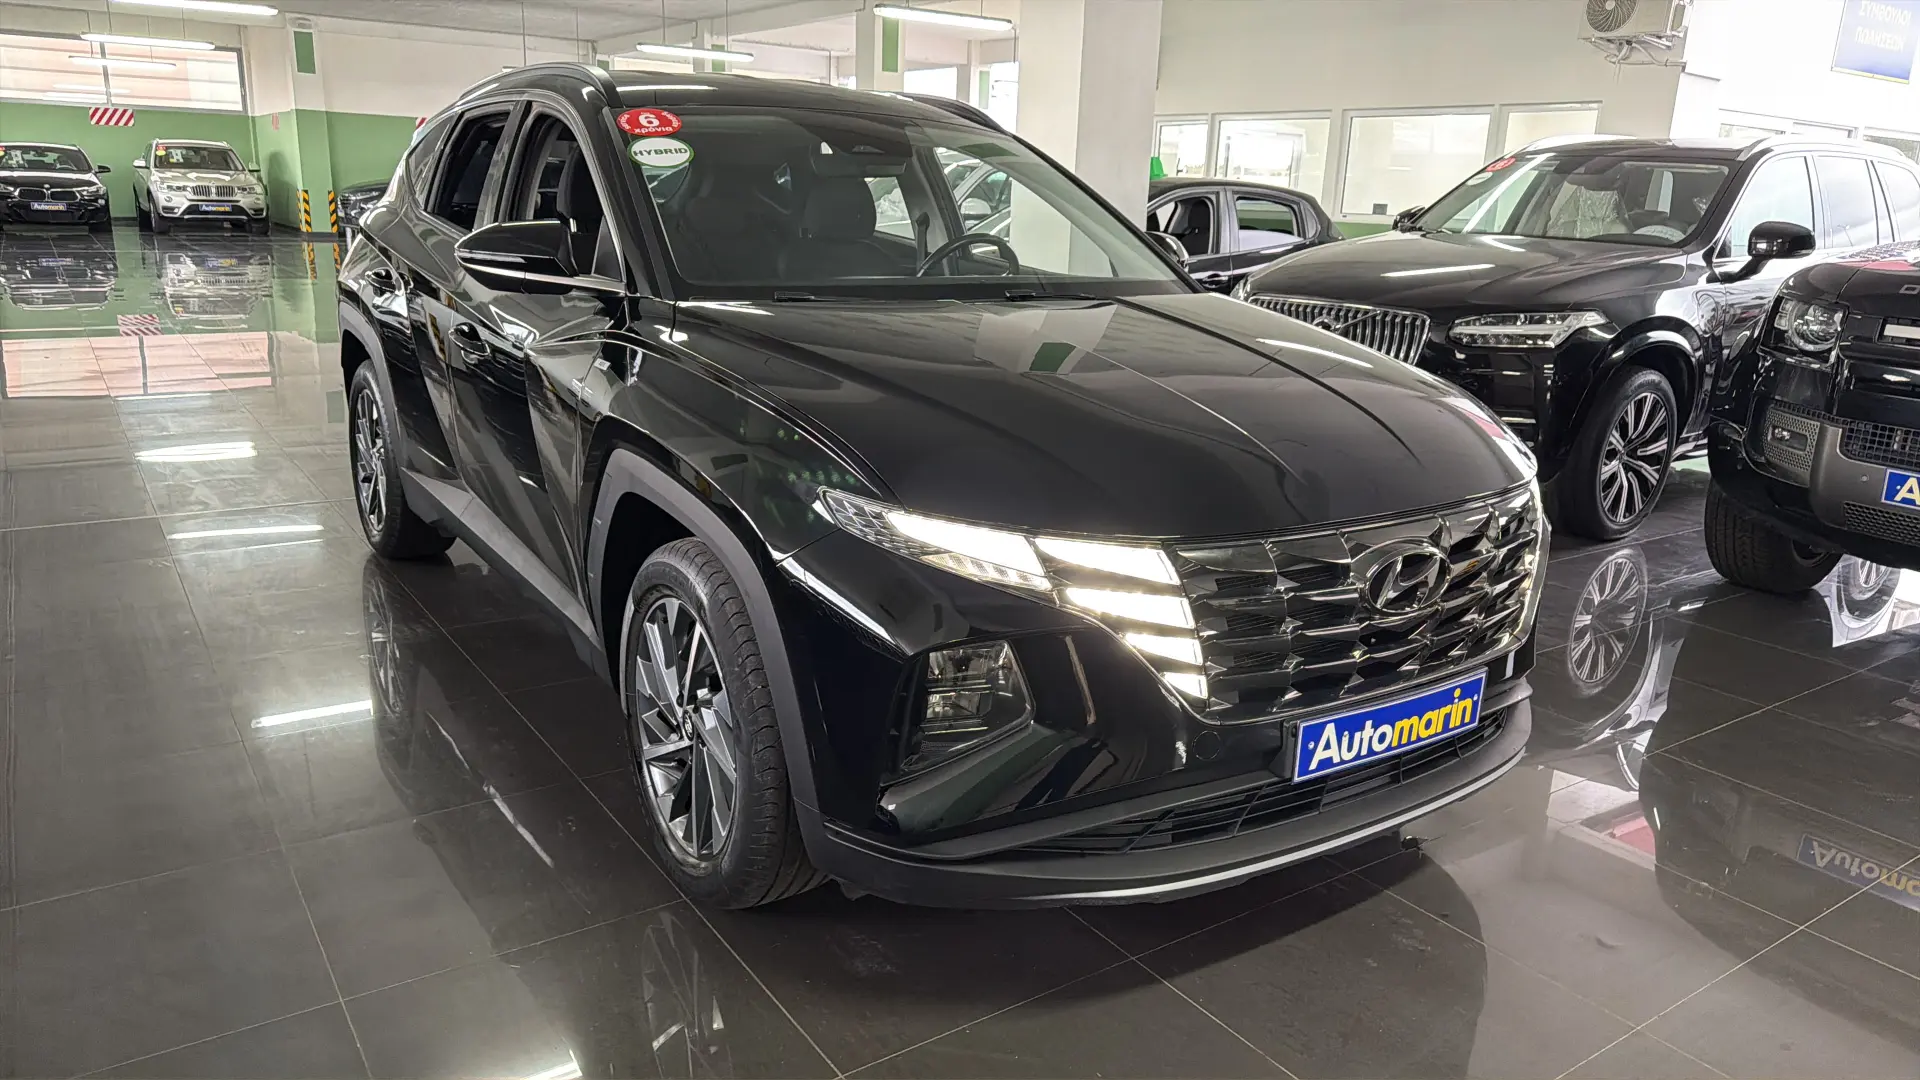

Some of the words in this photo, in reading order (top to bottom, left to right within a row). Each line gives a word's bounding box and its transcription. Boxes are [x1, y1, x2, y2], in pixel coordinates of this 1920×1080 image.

[638, 114, 660, 127] 6
[633, 147, 688, 157] HYBRID
[1308, 688, 1474, 771] Automarin
